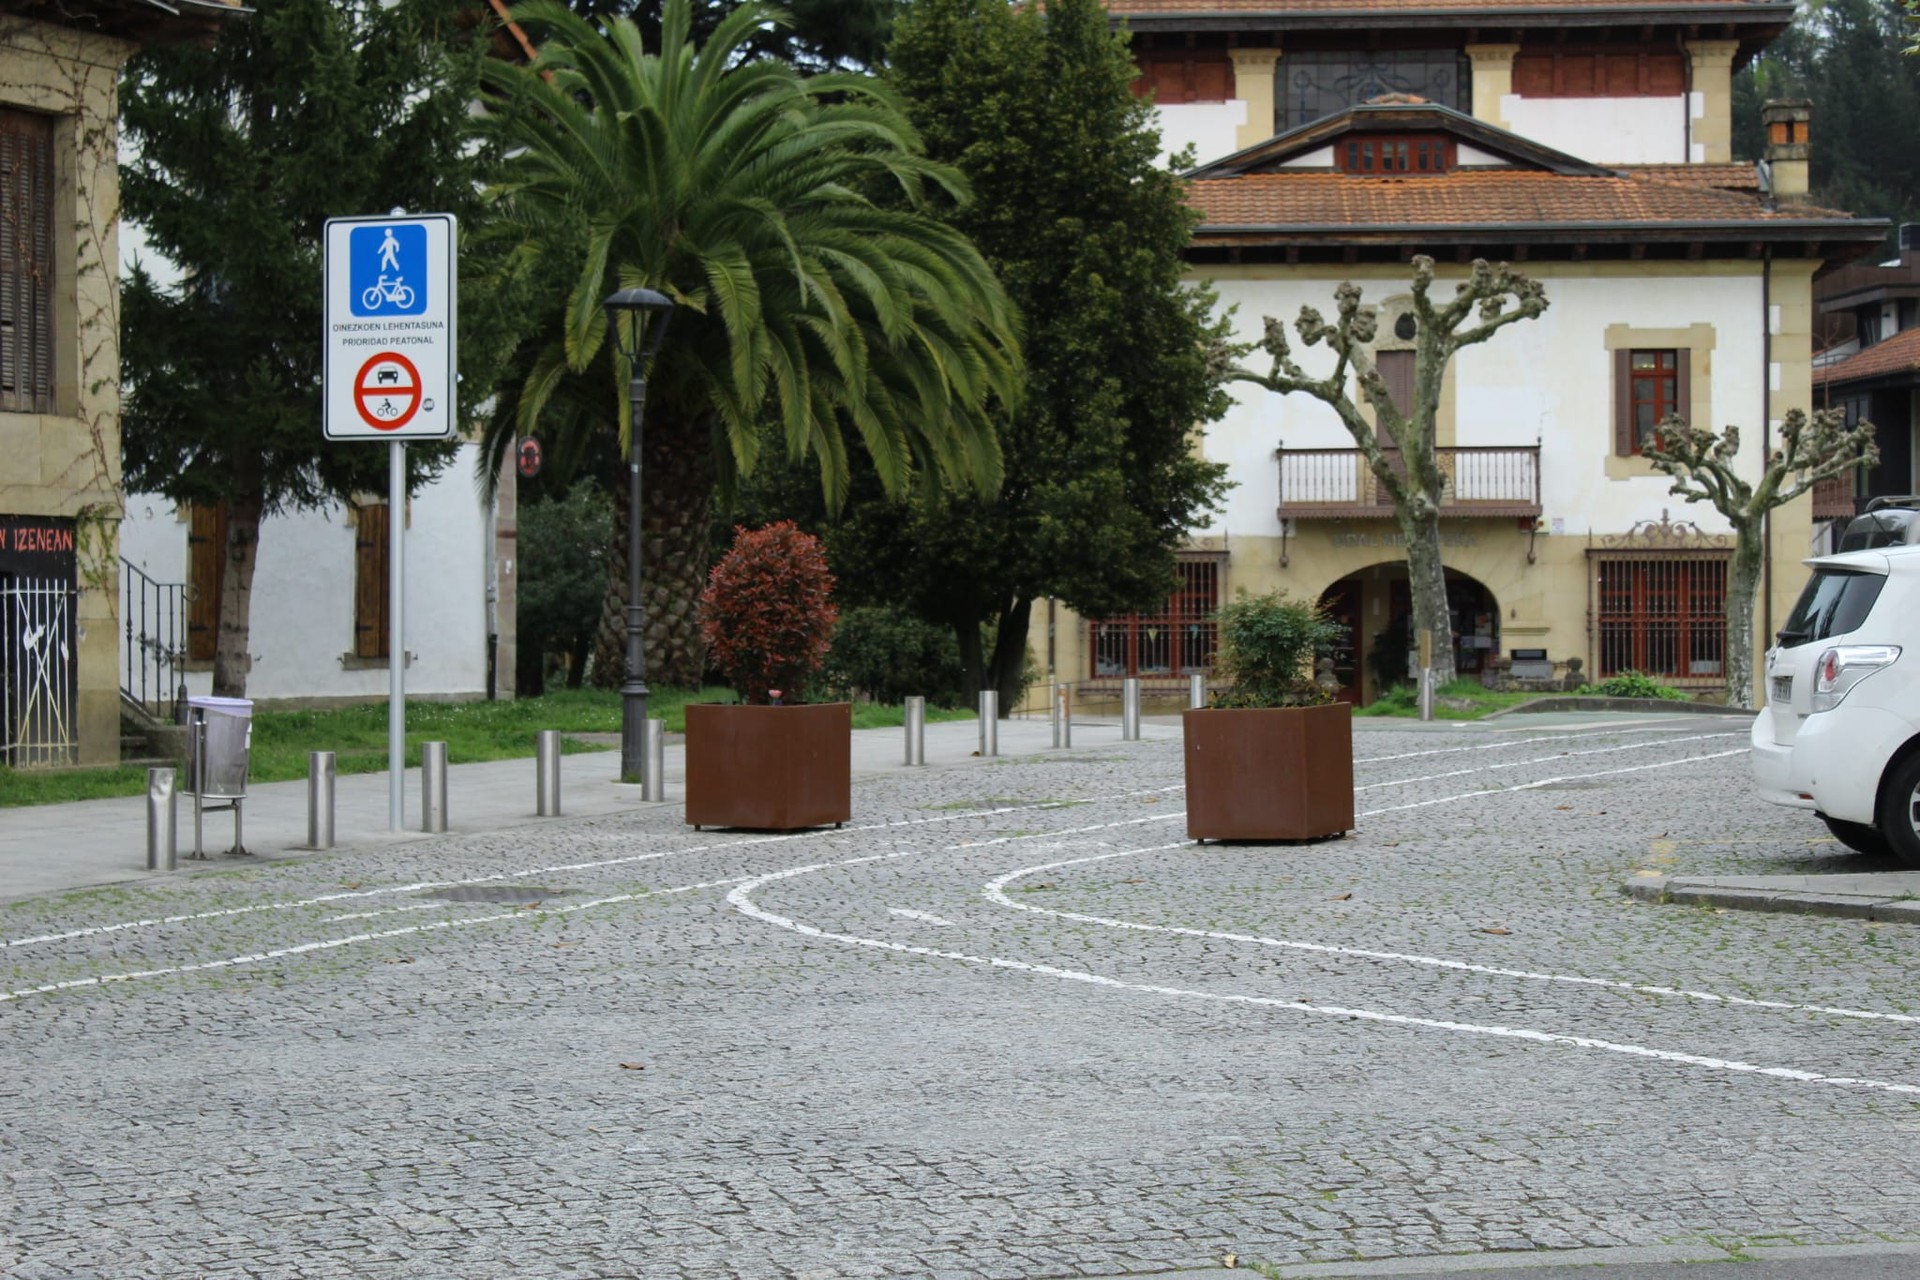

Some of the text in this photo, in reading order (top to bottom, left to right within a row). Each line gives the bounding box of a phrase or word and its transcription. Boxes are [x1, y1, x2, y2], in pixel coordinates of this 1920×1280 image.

[333, 321, 444, 332] OINEZKOEN LEHENTASUNA
[342, 336, 434, 346] PRIORIDAD PEATONAL
[14, 528, 73, 552] IZENEAN
